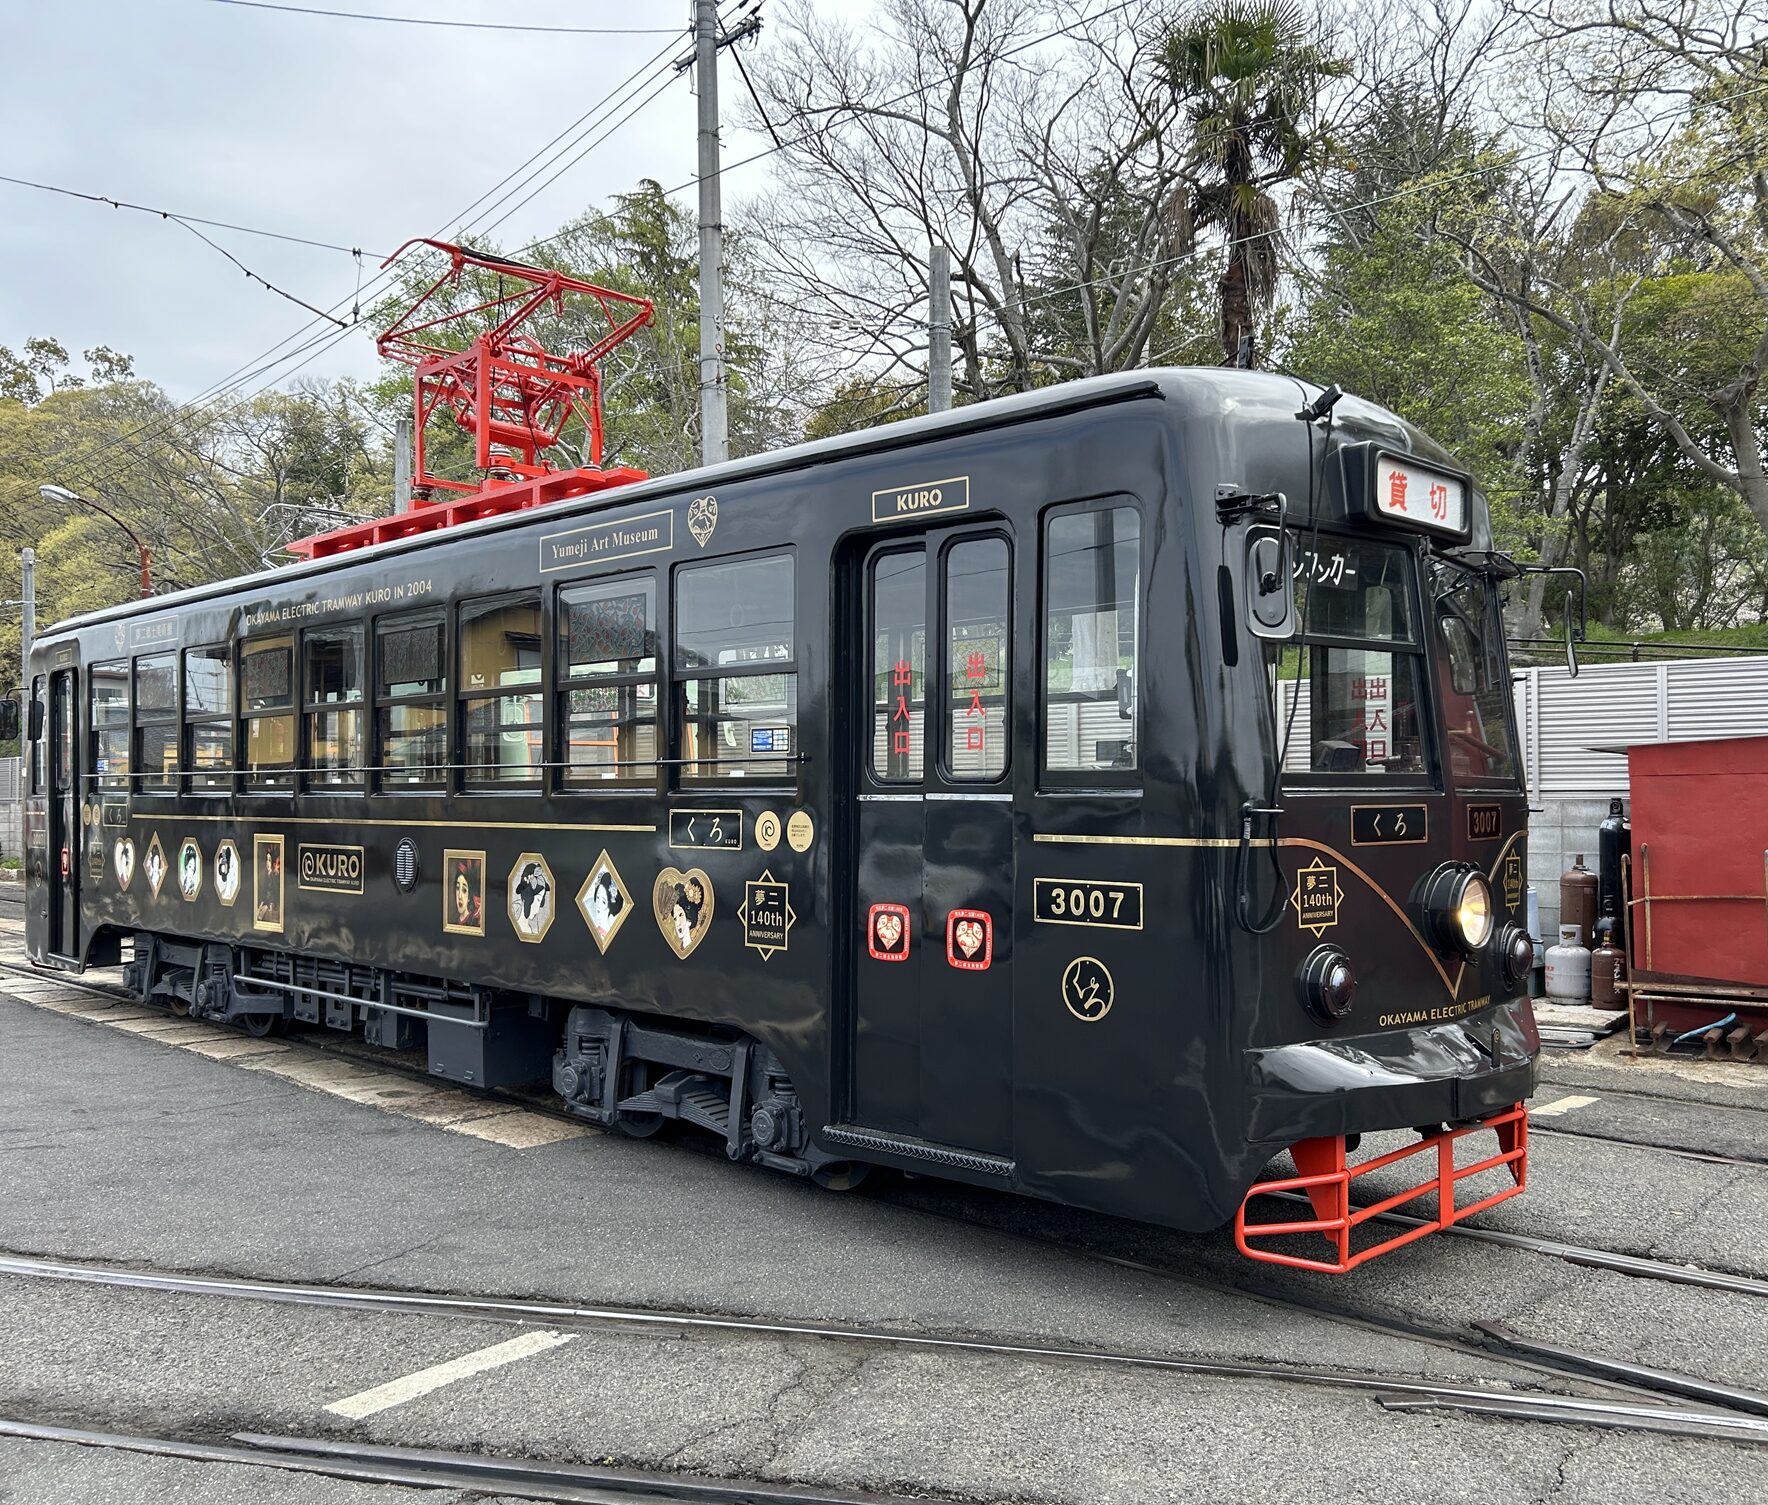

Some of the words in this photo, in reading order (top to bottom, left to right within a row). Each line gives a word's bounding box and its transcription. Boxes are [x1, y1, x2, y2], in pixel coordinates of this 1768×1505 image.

[896, 488, 943, 512] KURO
[1388, 470, 1447, 520] 貸切
[552, 539, 588, 559] Yumeji
[590, 536, 609, 552] Art
[612, 528, 659, 548] Museum
[246, 612, 281, 627] OKAYAMA
[282, 601, 320, 620] ELECTRIC
[321, 593, 363, 613] TRAMWAY
[365, 587, 391, 605] KURO
[394, 585, 404, 599] IN
[407, 579, 432, 597] 2004
[893, 658, 912, 754] 出入口
[966, 650, 986, 751] 出入口
[108, 808, 122, 823] くろ
[1372, 812, 1407, 837] くろ
[1472, 811, 1497, 834] 3007
[687, 816, 723, 842] くろ
[1306, 875, 1329, 891] 夢二
[754, 889, 779, 906] 夢二
[1051, 888, 1125, 919] 3007
[1303, 892, 1333, 908] 140th
[750, 910, 783, 927] 140th
[1302, 910, 1334, 919] ANNIVERSARY
[748, 929, 784, 940] ANNIVERSARY
[1379, 1010, 1428, 1027] OKAYAMA
[1430, 1003, 1467, 1020] ELECTRIC
[1467, 995, 1491, 1011] TRAMWAY
